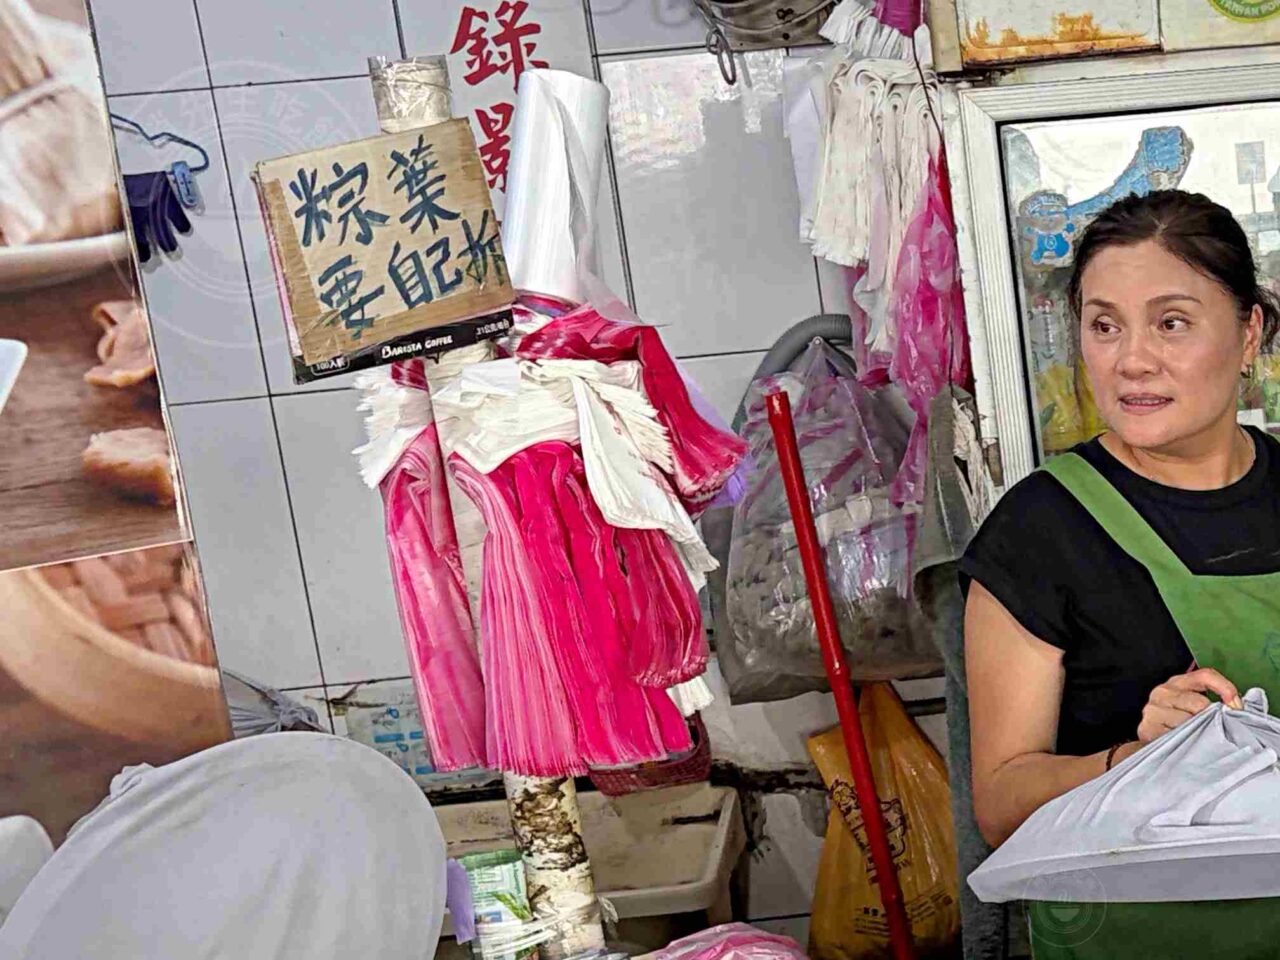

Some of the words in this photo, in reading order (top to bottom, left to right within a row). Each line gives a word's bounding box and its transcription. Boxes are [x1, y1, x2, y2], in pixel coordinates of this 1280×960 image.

[290, 134, 460, 247] 粽葉
[382, 342, 422, 359] BARISTA
[425, 335, 453, 349] COFFEE
